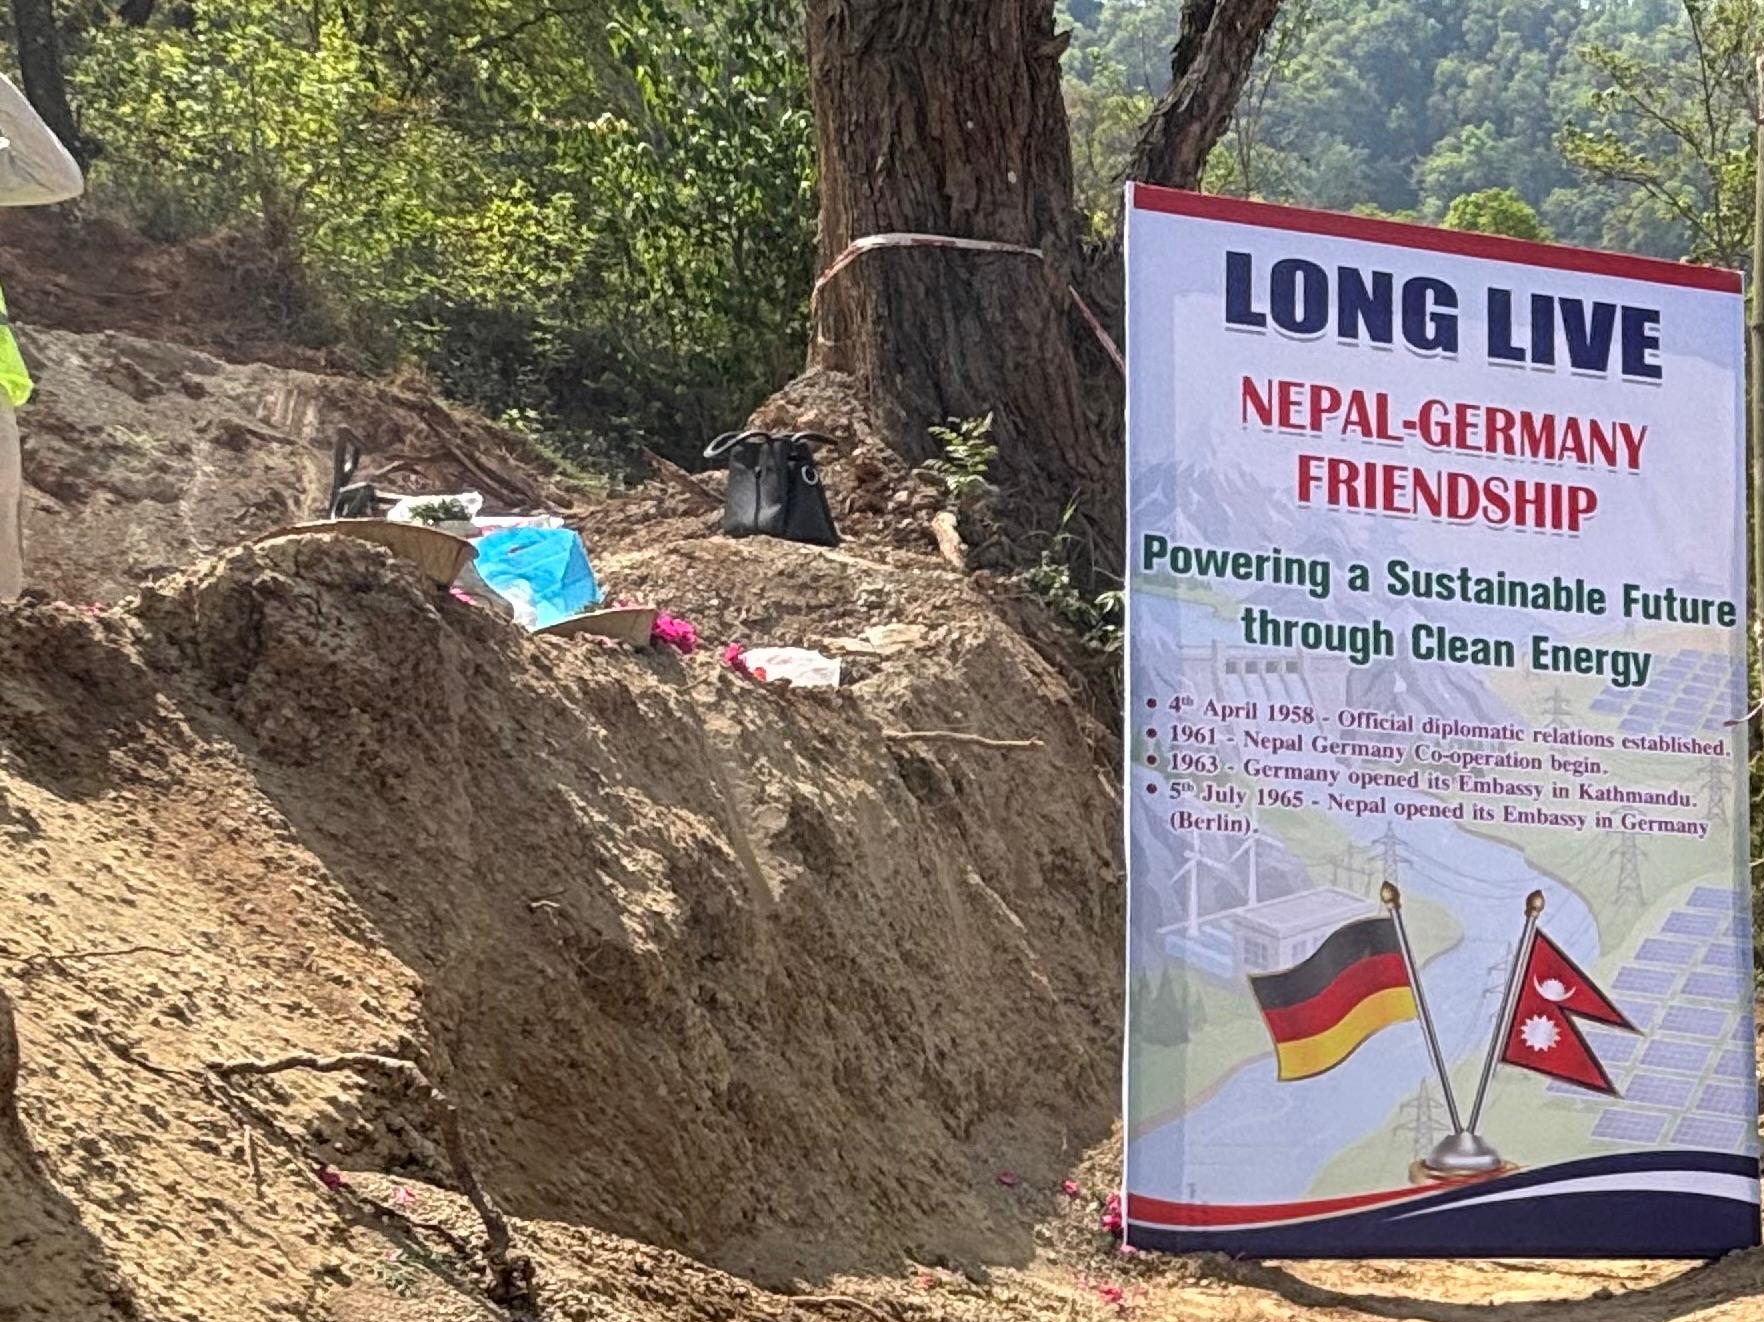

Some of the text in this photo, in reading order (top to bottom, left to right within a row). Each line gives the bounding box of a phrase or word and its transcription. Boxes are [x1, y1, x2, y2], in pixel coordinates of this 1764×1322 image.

[1225, 251, 1662, 379] LONG LIVE
[1242, 376, 1648, 469] NEPAL-GERMANY
[1298, 455, 1597, 531] FRIENDSHIP
[1143, 534, 1737, 627] Powering a Sustainable Future
[1242, 609, 1651, 687] through Clean Energy
[1168, 694, 1194, 713] 4th
[1204, 698, 1257, 722] April
[1268, 703, 1315, 724] 1958
[1338, 708, 1413, 733] Official
[1422, 716, 1525, 743] diplomatic
[1533, 727, 1615, 749] relations
[1621, 735, 1731, 757] established.
[1170, 724, 1216, 745] 1961
[1244, 730, 1303, 755] Nepal
[1311, 734, 1405, 763] Germany
[1415, 743, 1543, 771] Co-operation
[1550, 754, 1609, 777] begin.
[1169, 781, 1195, 800] 5th
[1202, 784, 1247, 809] July
[1257, 788, 1304, 808] 1965
[1327, 793, 1386, 817] Nepal
[1393, 801, 1464, 823] opened
[1473, 803, 1495, 821] its
[1503, 805, 1587, 832] Embassy
[1595, 811, 1613, 829] in
[1621, 812, 1709, 839] Germany
[1170, 752, 1219, 774] 1963
[1243, 758, 1340, 786] Germany
[1348, 772, 1419, 794] opened
[1427, 772, 1450, 791] its
[1459, 775, 1544, 801] Embassy
[1552, 781, 1569, 799] in
[1578, 783, 1698, 807] Kathmandu.
[1170, 810, 1260, 835] (Berlin).
